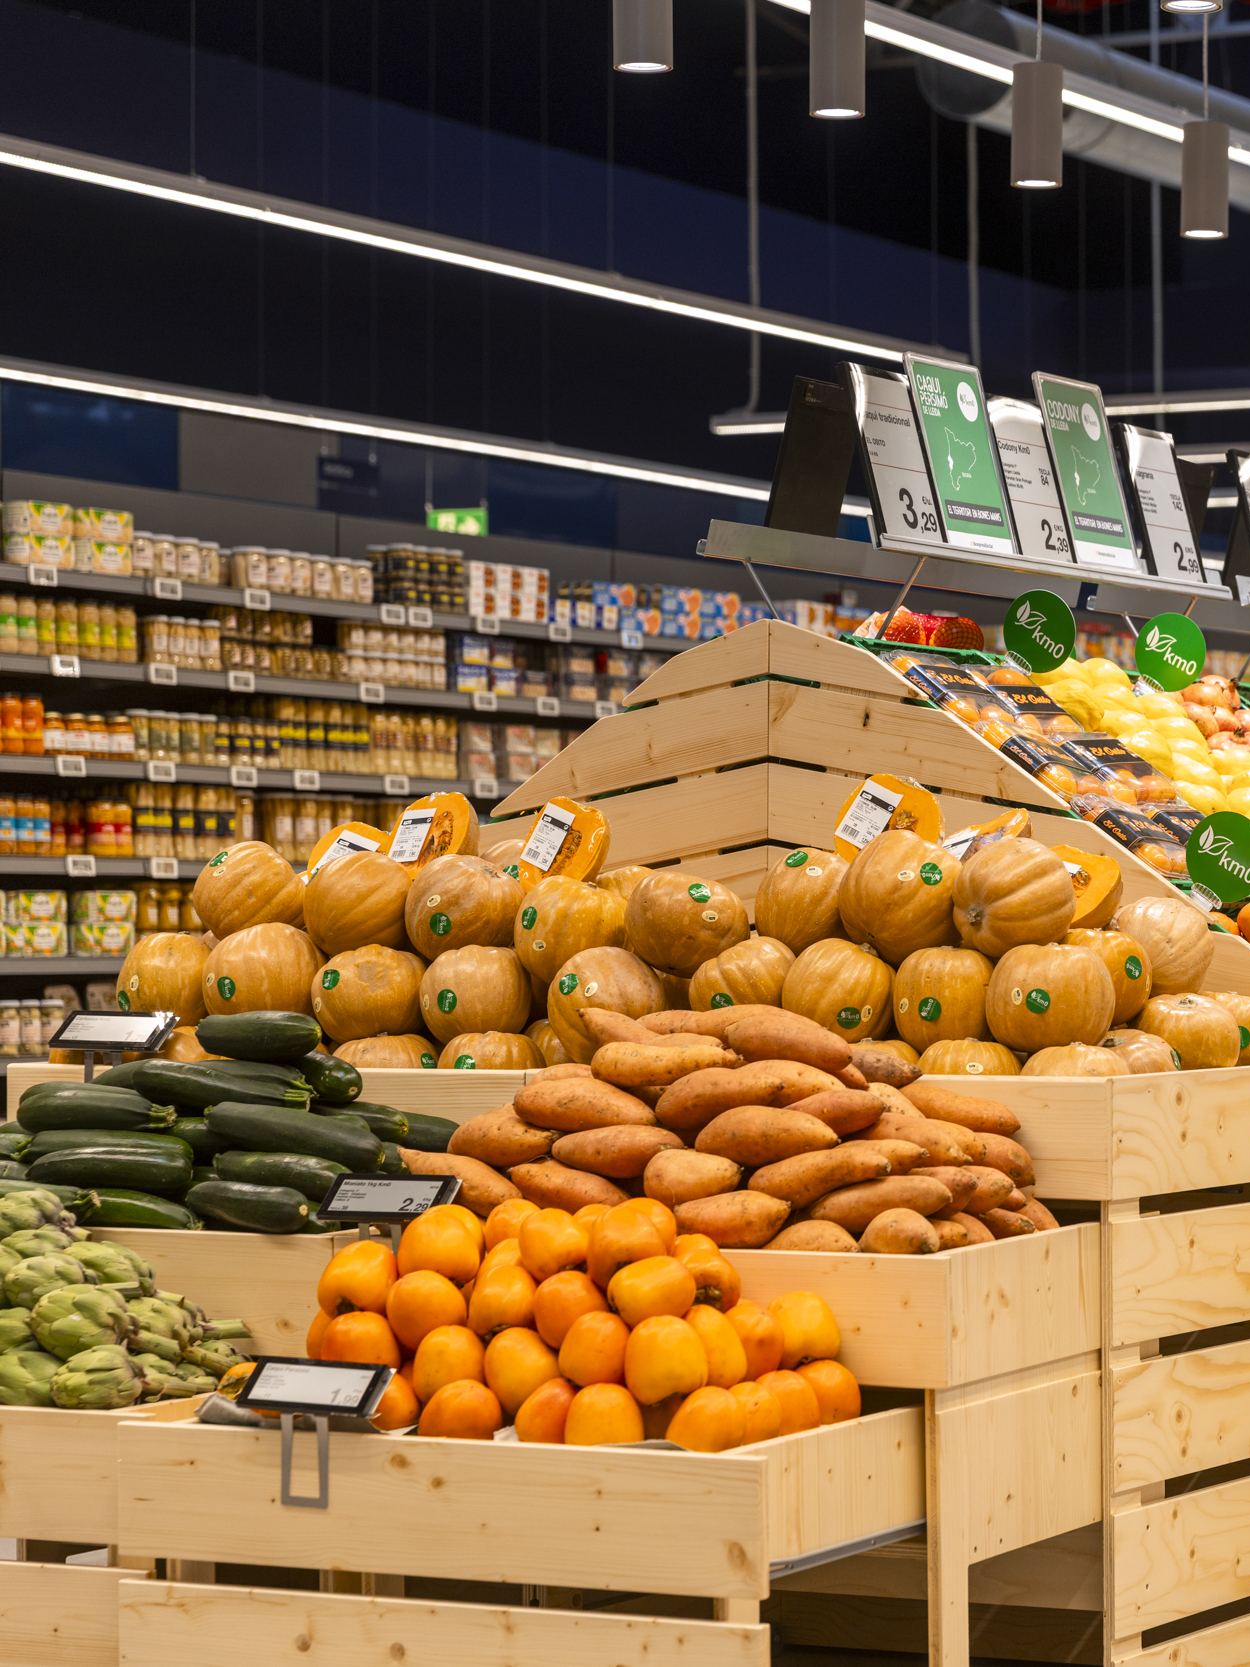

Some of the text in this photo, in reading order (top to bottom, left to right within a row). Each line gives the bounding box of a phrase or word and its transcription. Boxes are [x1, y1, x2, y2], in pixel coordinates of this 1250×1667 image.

[916, 374, 942, 394] CAQUI
[919, 391, 948, 409] PERSIMÓ
[865, 411, 911, 427] aqui tradicional
[929, 407, 941, 417] LLEIDA
[1046, 399, 1080, 424] CODONY
[1056, 420, 1070, 432] LLEIDA
[997, 440, 1030, 455] Codony Km0
[1136, 470, 1155, 480] agrana
[1041, 518, 1069, 554] 2,39
[1173, 541, 1199, 574] 2,99
[1032, 625, 1065, 659] km0
[1163, 646, 1197, 676] km0
[398, 1197, 429, 1213] 2,29
